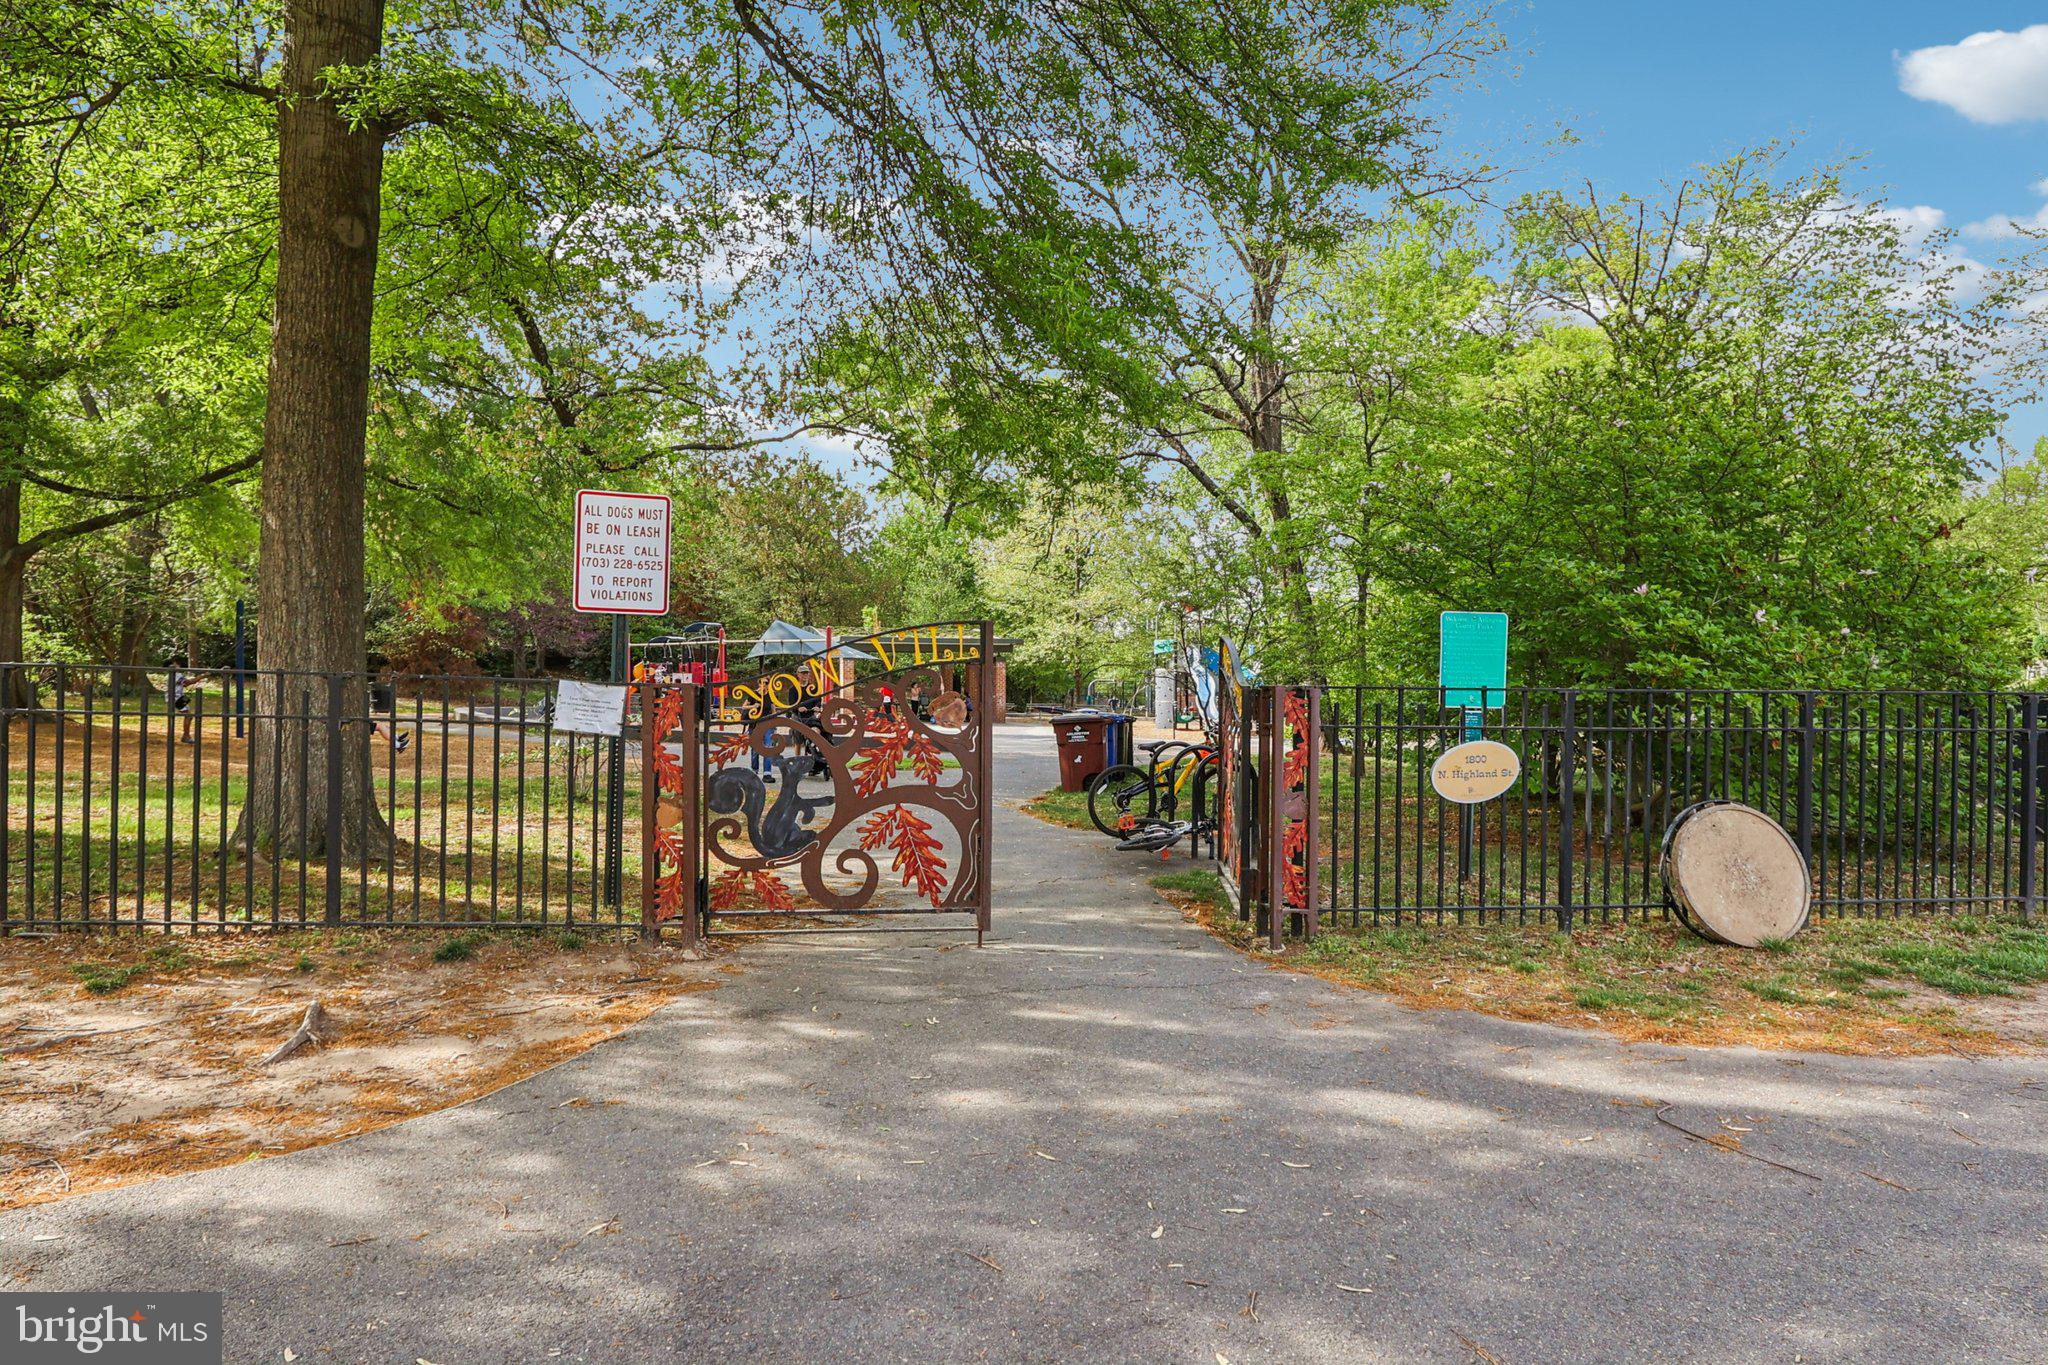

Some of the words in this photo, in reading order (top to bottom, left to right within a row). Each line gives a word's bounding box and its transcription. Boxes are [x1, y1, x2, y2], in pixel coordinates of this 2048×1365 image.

[584, 505, 602, 517] ALL
[607, 506, 633, 519] DOGS
[638, 508, 663, 520] MUST
[586, 523, 599, 534] BE
[606, 524, 620, 535] ON
[627, 525, 660, 538] LEASH
[586, 543, 625, 555] PLEASE
[634, 546, 659, 557] CALL
[582, 557, 609, 568] (703)
[613, 559, 663, 571] 228-6525
[591, 575, 604, 586] TO
[612, 576, 653, 588] REPORT
[591, 589, 653, 602] VIOLATIONS
[719, 649, 840, 722] LYON
[869, 624, 980, 671] VILL
[1465, 755, 1487, 764] 1800
[1438, 770, 1449, 779] N.
[1452, 769, 1498, 781] Highland
[1501, 768, 1515, 777] St.
